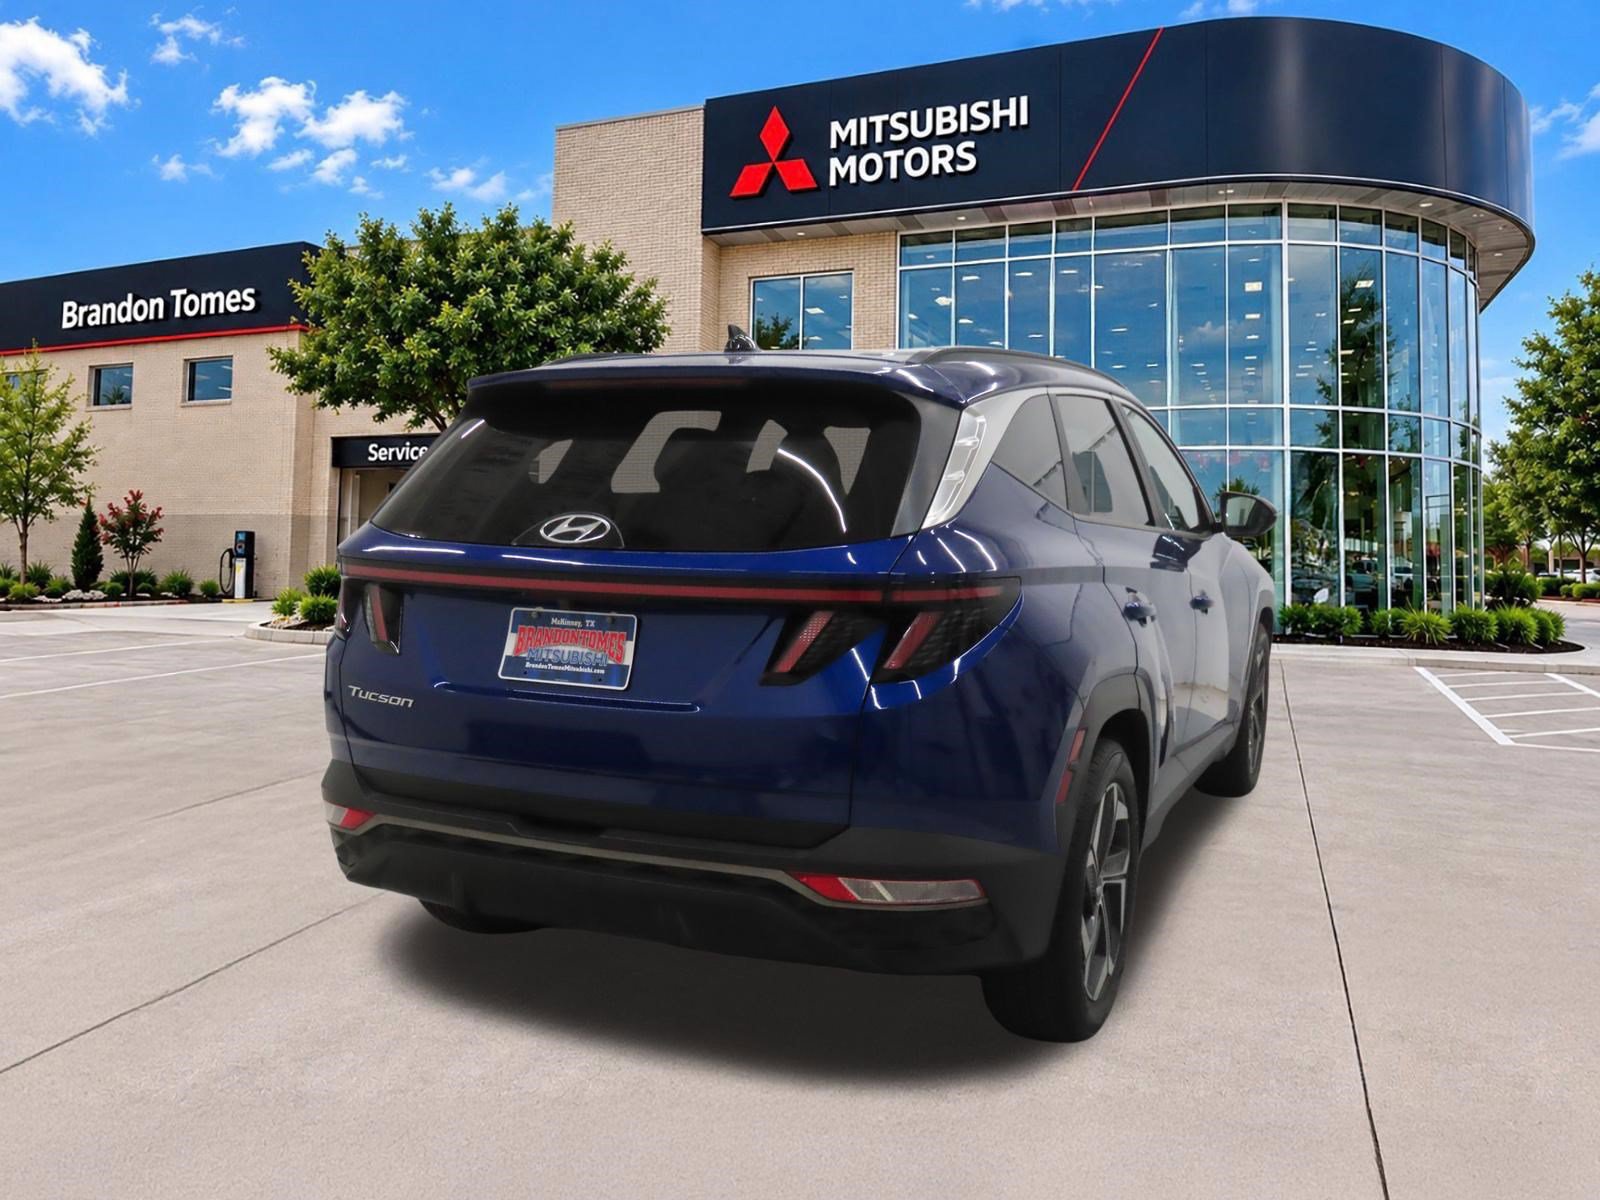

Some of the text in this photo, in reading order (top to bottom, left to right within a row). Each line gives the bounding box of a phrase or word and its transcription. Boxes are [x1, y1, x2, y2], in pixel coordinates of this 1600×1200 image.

[829, 95, 1029, 149] MITSUBISHI
[828, 141, 977, 187] MOTORS
[61, 288, 256, 329] Brandon Tomes
[551, 617, 596, 628] McKinney, TX
[525, 661, 605, 674] BrandonTomesMitsubishi.com
[526, 649, 608, 666] MITSUBISHI
